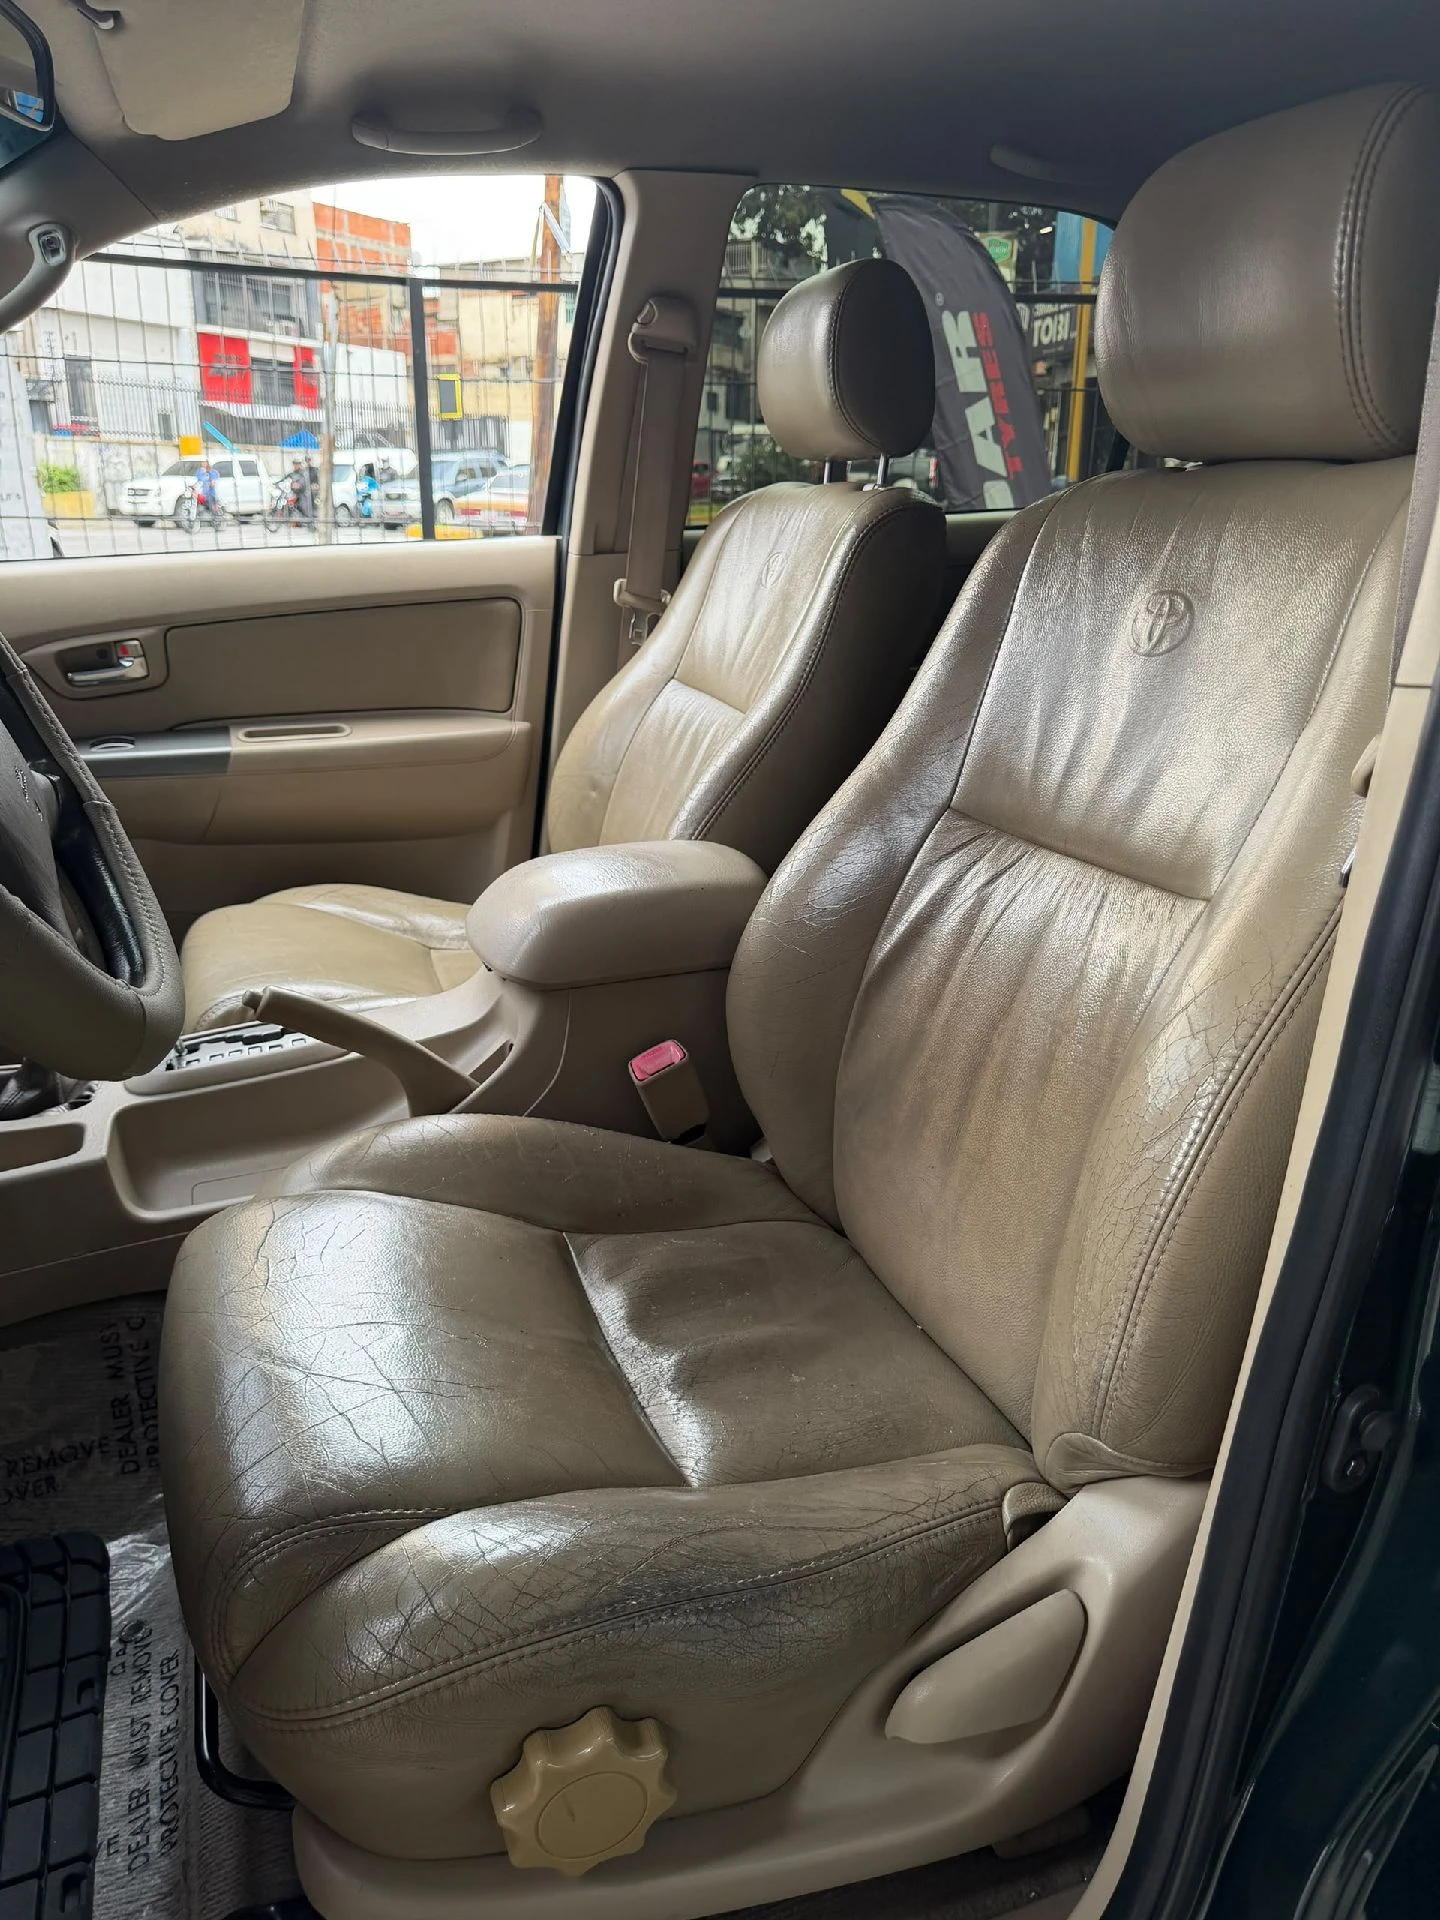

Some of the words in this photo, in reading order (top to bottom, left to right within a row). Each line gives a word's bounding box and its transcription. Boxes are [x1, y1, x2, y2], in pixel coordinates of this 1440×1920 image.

[971, 312, 1023, 480] TYRES
[6, 1436, 110, 1478] REMOVE
[111, 1392, 140, 1476] DEALER
[160, 1649, 179, 1716] COVER
[128, 1713, 151, 1773] MUST
[128, 1781, 151, 1875] DEALER
[158, 1718, 180, 1857] PROTECTIVE
